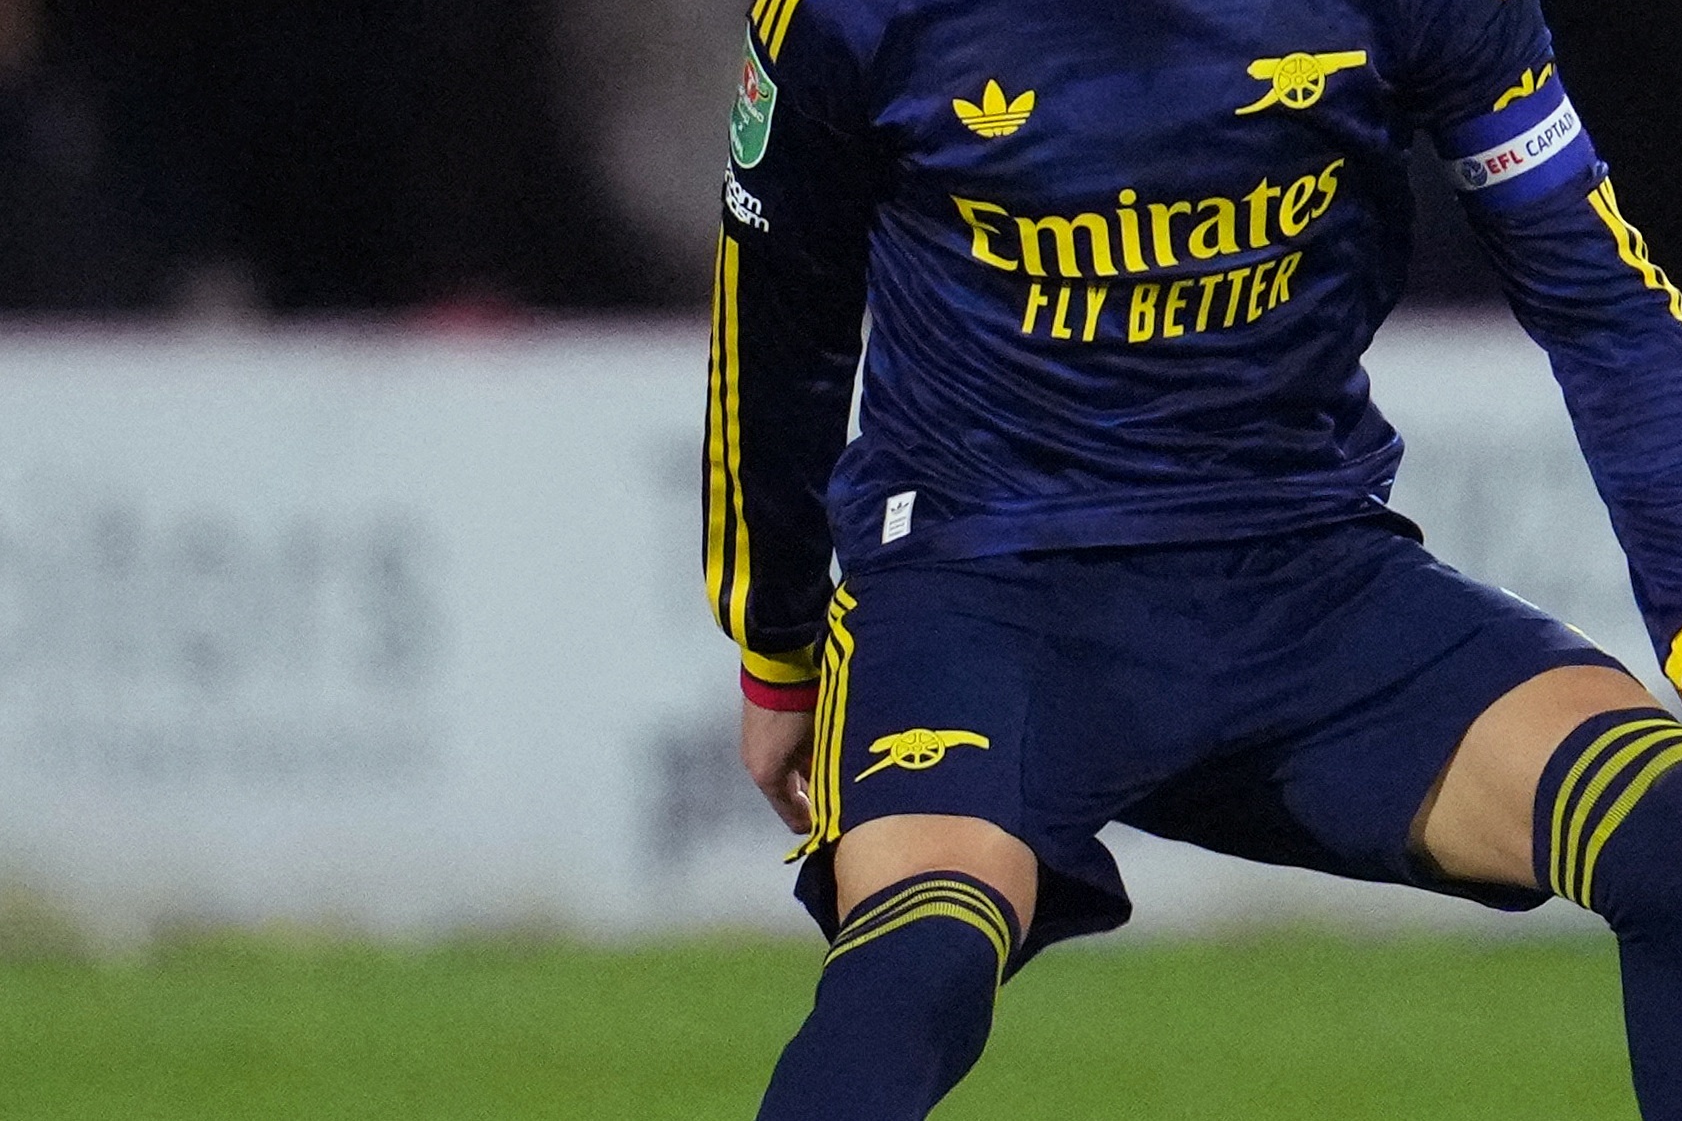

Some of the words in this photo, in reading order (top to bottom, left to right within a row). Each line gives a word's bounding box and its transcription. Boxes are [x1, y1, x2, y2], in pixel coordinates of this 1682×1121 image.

[1486, 150, 1523, 175] EFL
[950, 157, 1345, 277] Emirates
[1021, 282, 1109, 342] FLY
[1128, 251, 1303, 344] BETTER
